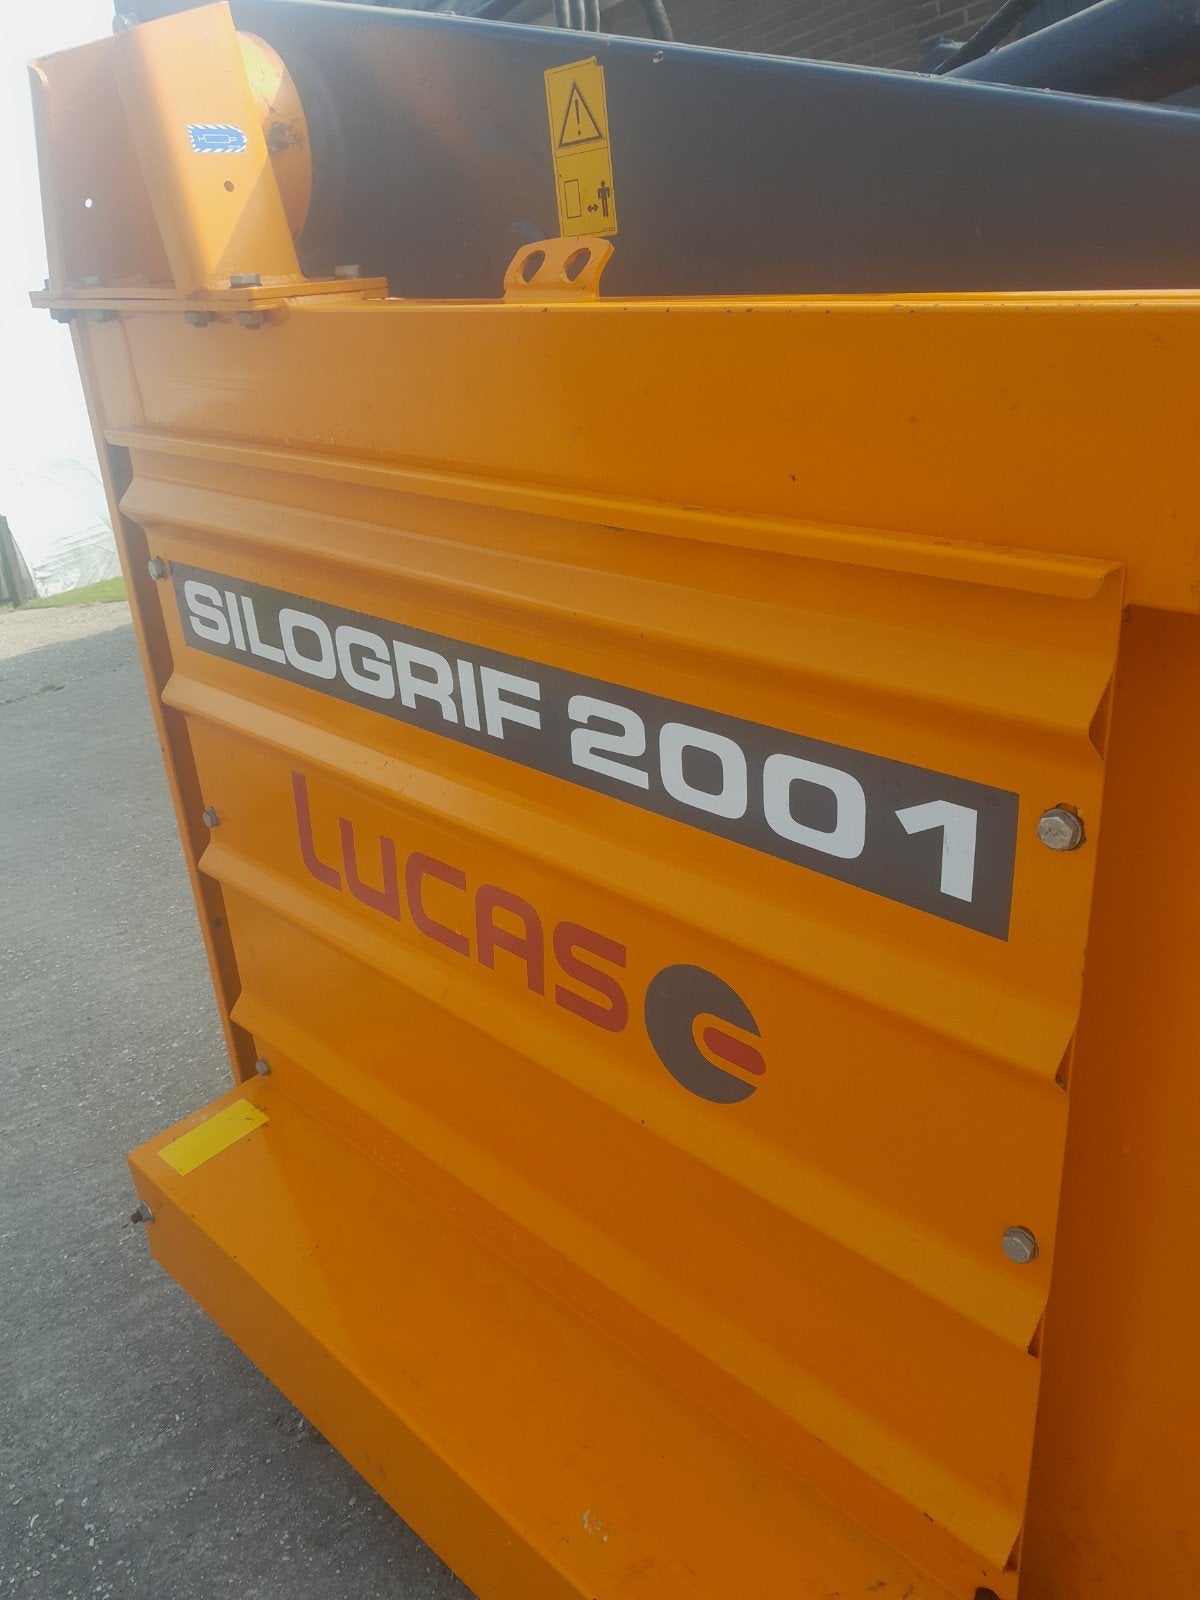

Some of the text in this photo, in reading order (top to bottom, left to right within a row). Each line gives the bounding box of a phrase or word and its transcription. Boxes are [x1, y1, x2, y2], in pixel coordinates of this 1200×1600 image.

[184, 579, 978, 902] SILOGRIF 2001
[291, 771, 628, 1033] LUCAS
